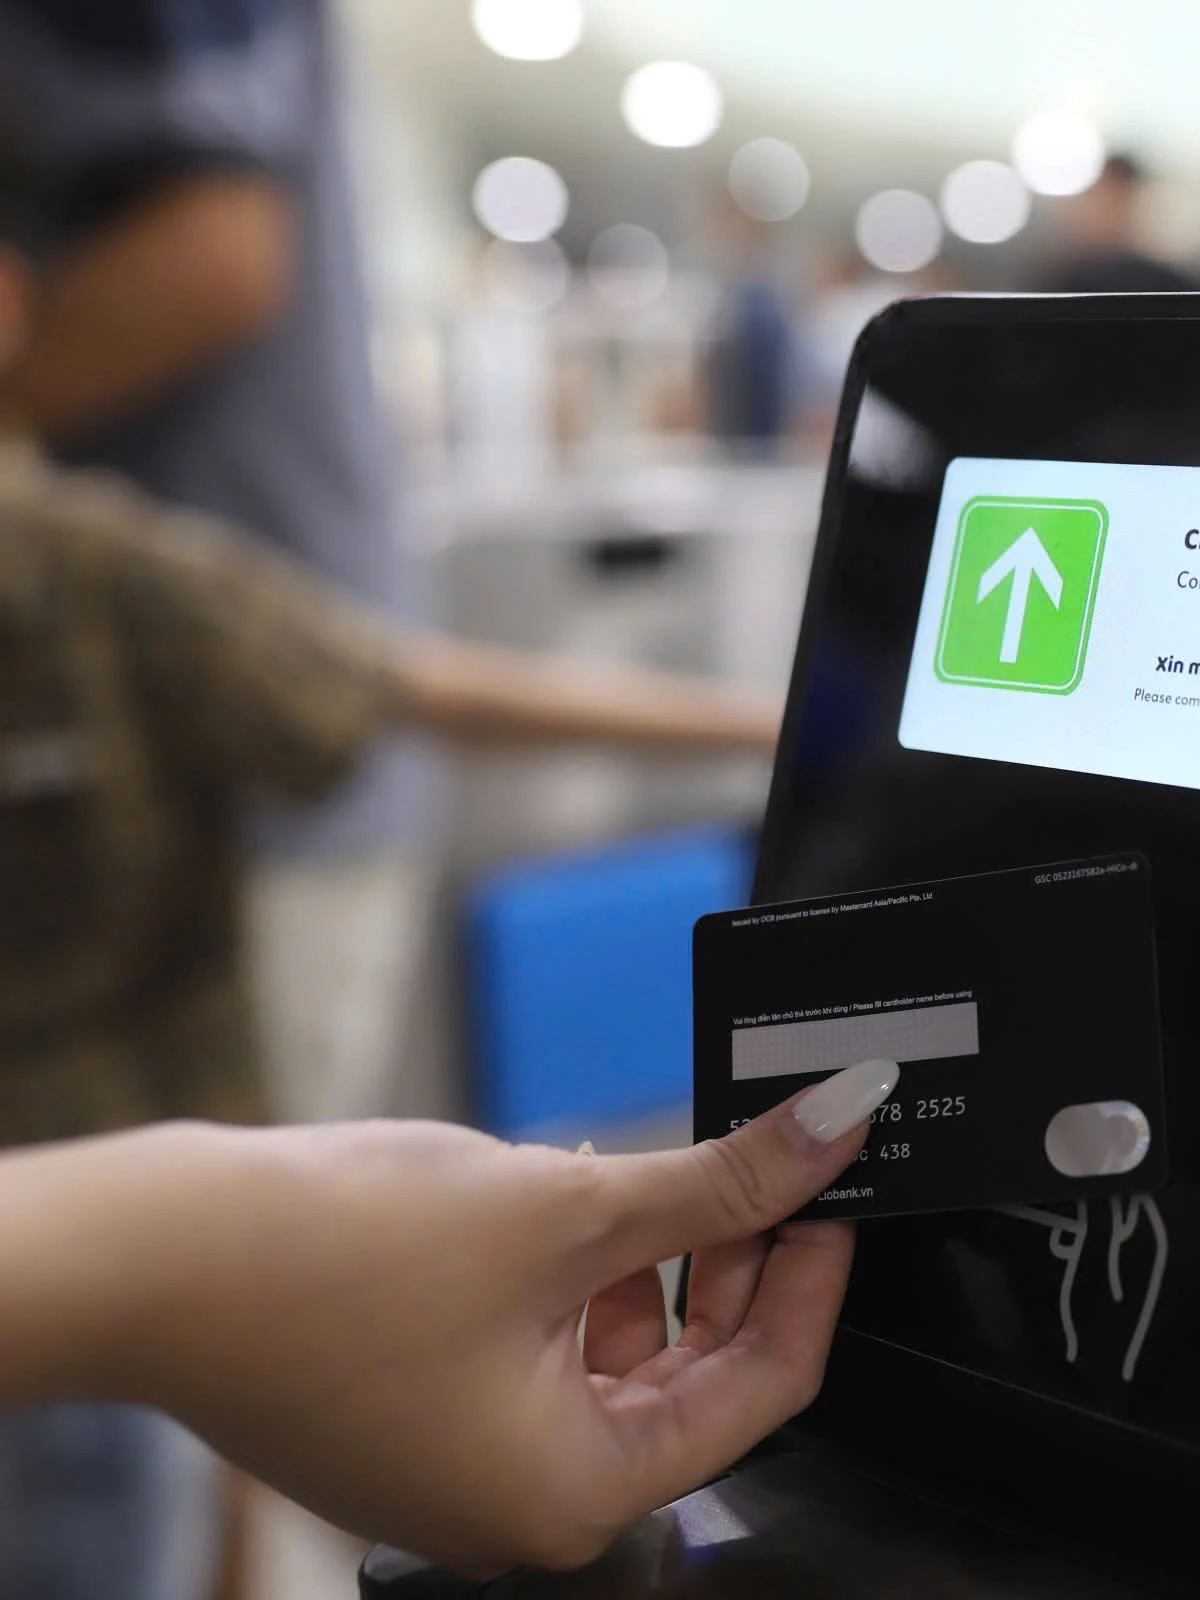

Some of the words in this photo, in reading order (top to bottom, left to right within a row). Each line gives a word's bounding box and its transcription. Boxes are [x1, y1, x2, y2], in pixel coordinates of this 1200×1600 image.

[1155, 655, 1184, 673] Xin
[1134, 688, 1172, 704] Please
[1034, 873, 1051, 884] GSC
[761, 914, 774, 922] OCB
[776, 911, 802, 922] pursuant
[809, 907, 830, 916] license
[831, 905, 840, 914] by
[840, 902, 873, 911] Mastercard
[873, 896, 908, 907] Asia/Pacific
[923, 892, 933, 900] Ltd
[733, 1017, 744, 1025] Vui
[853, 1001, 874, 1011] Please
[882, 997, 915, 1007] cardholder
[915, 994, 934, 1003] name
[934, 992, 955, 1001] before
[955, 990, 972, 998] using
[872, 1102, 902, 1124] 78
[916, 1096, 966, 1120] 2525
[879, 1142, 911, 1160] 438
